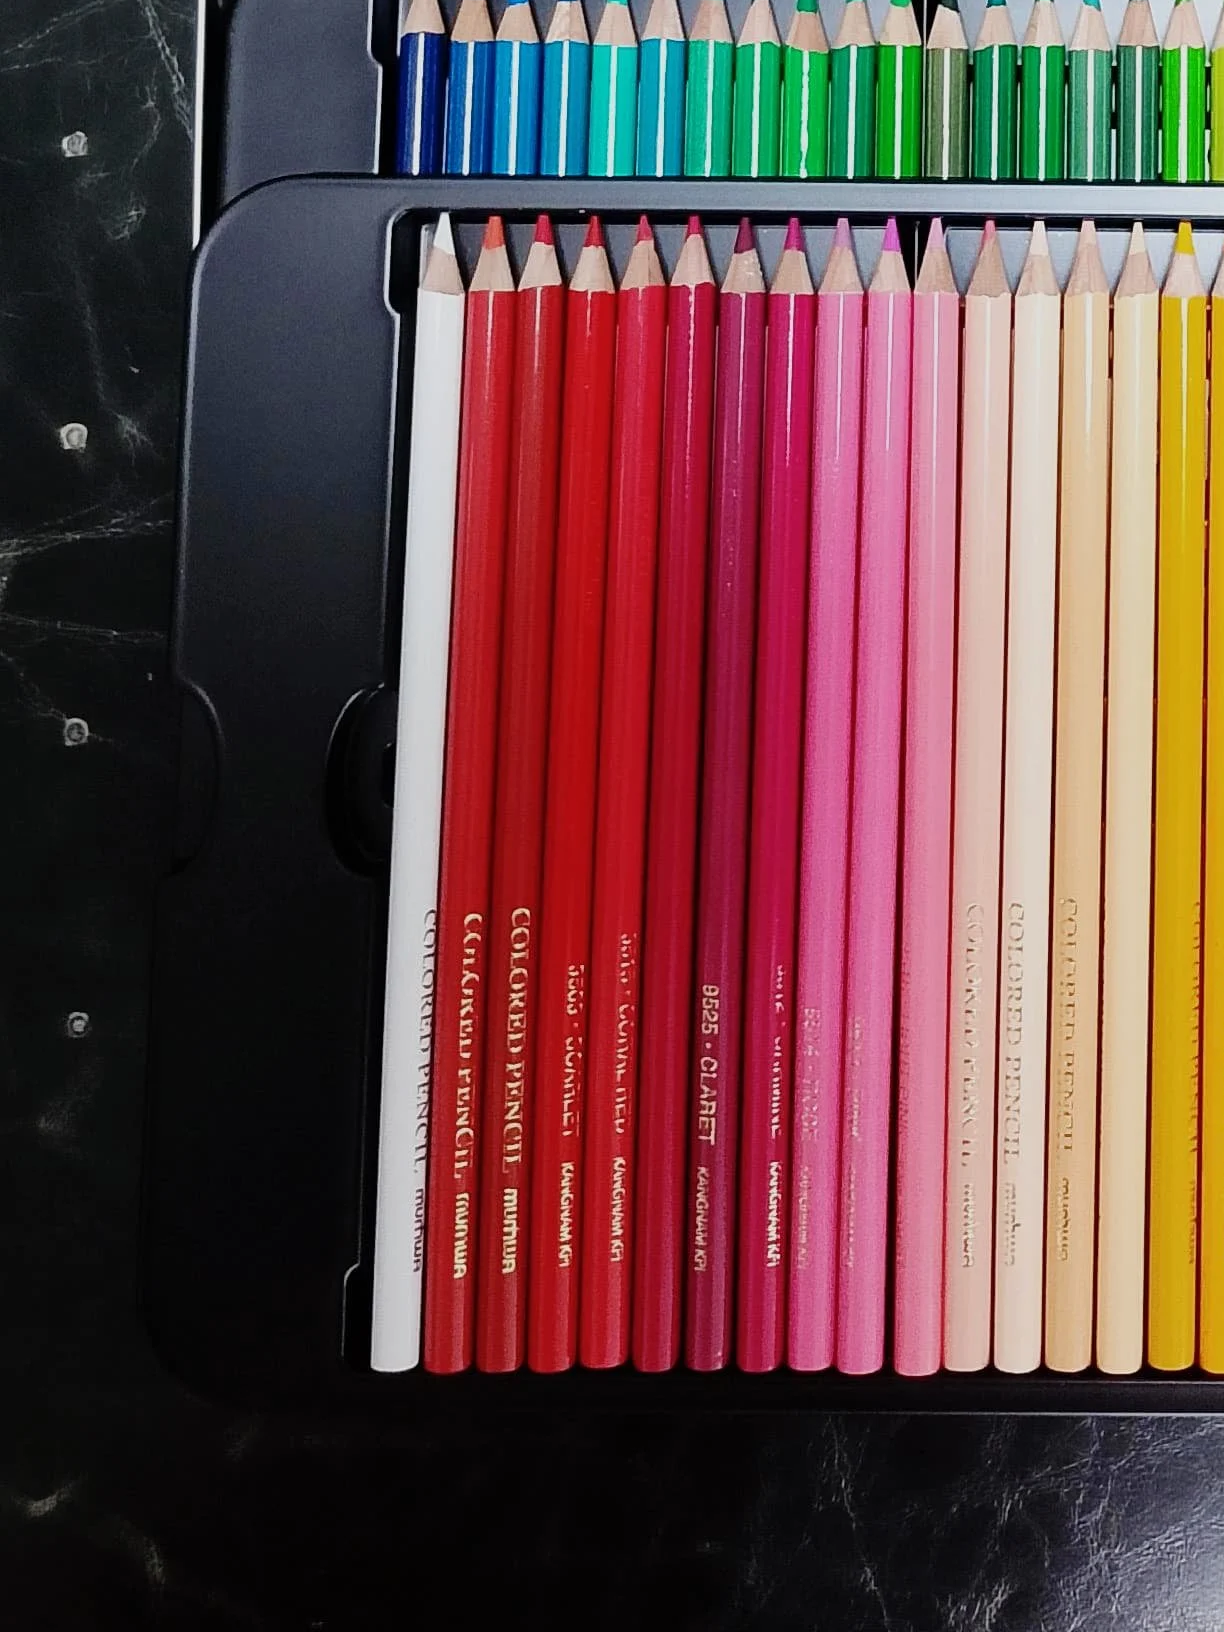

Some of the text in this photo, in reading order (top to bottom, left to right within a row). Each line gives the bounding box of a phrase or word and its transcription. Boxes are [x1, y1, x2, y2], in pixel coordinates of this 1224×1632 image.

[459, 913, 482, 1059] COLORED
[507, 907, 531, 1054] COLORED
[963, 903, 985, 1048] COLORED
[1005, 902, 1024, 1046] COLORED
[1058, 898, 1078, 1041] COLORED
[453, 1068, 475, 1179] PENCIL
[503, 1062, 524, 1173] PENCIL
[693, 984, 720, 1272] 9525 CLARET KANGNAM KPI
[1003, 1056, 1021, 1165] PENCIL
[1056, 1050, 1074, 1160] PENCIL
